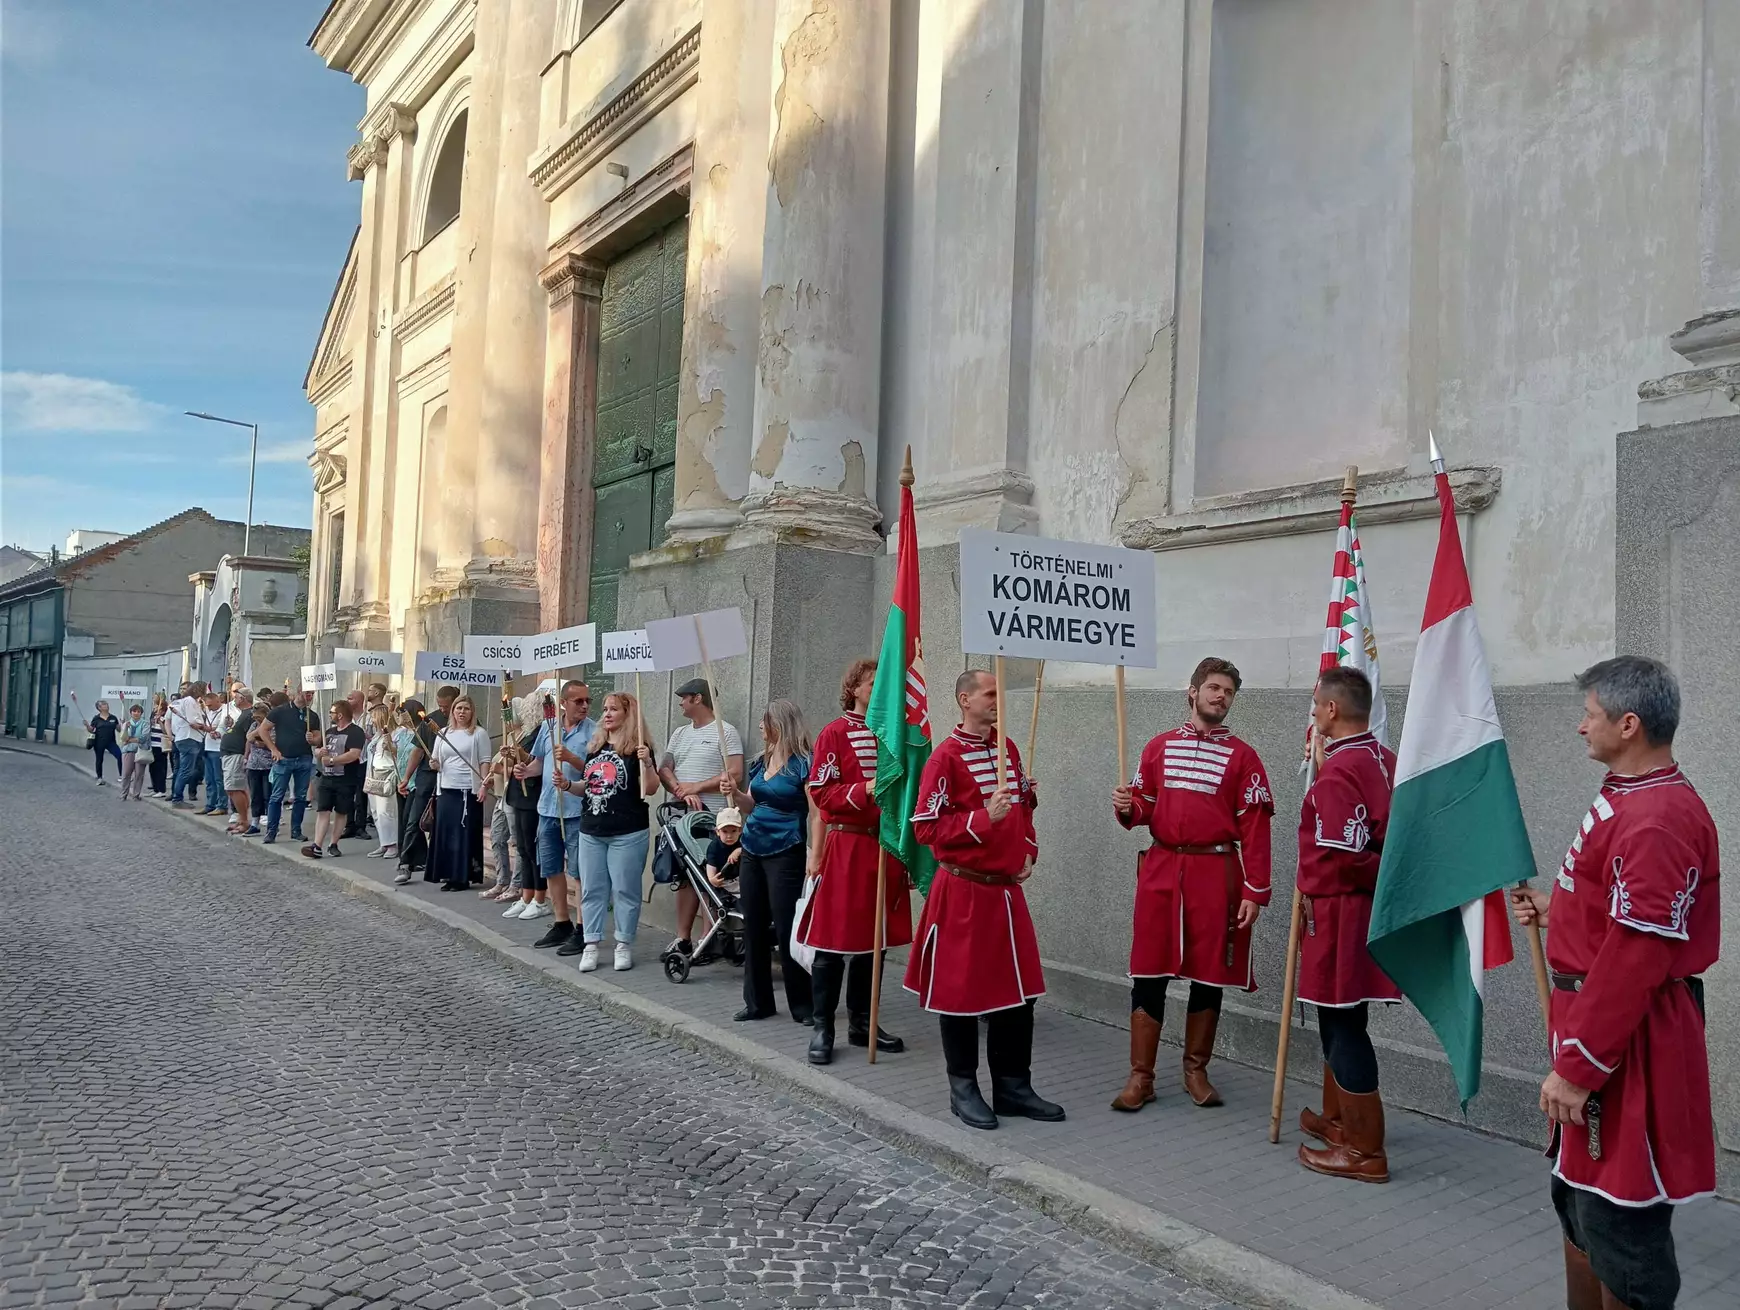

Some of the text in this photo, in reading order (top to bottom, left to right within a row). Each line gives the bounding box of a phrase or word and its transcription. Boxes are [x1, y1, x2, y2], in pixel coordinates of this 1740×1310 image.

[1010, 551, 1113, 579] TÖRTÉNELMI
[993, 574, 1131, 612] KOMÁROM
[987, 606, 1136, 648] VÁRMEGYE
[482, 644, 522, 659] CSICSÓ
[533, 639, 580, 660] PERBETE
[605, 643, 653, 661] ALMÁSFÜZ
[358, 655, 385, 666] GÚTA
[442, 655, 466, 669] ÉSZ
[431, 670, 497, 684] KOMÁROM
